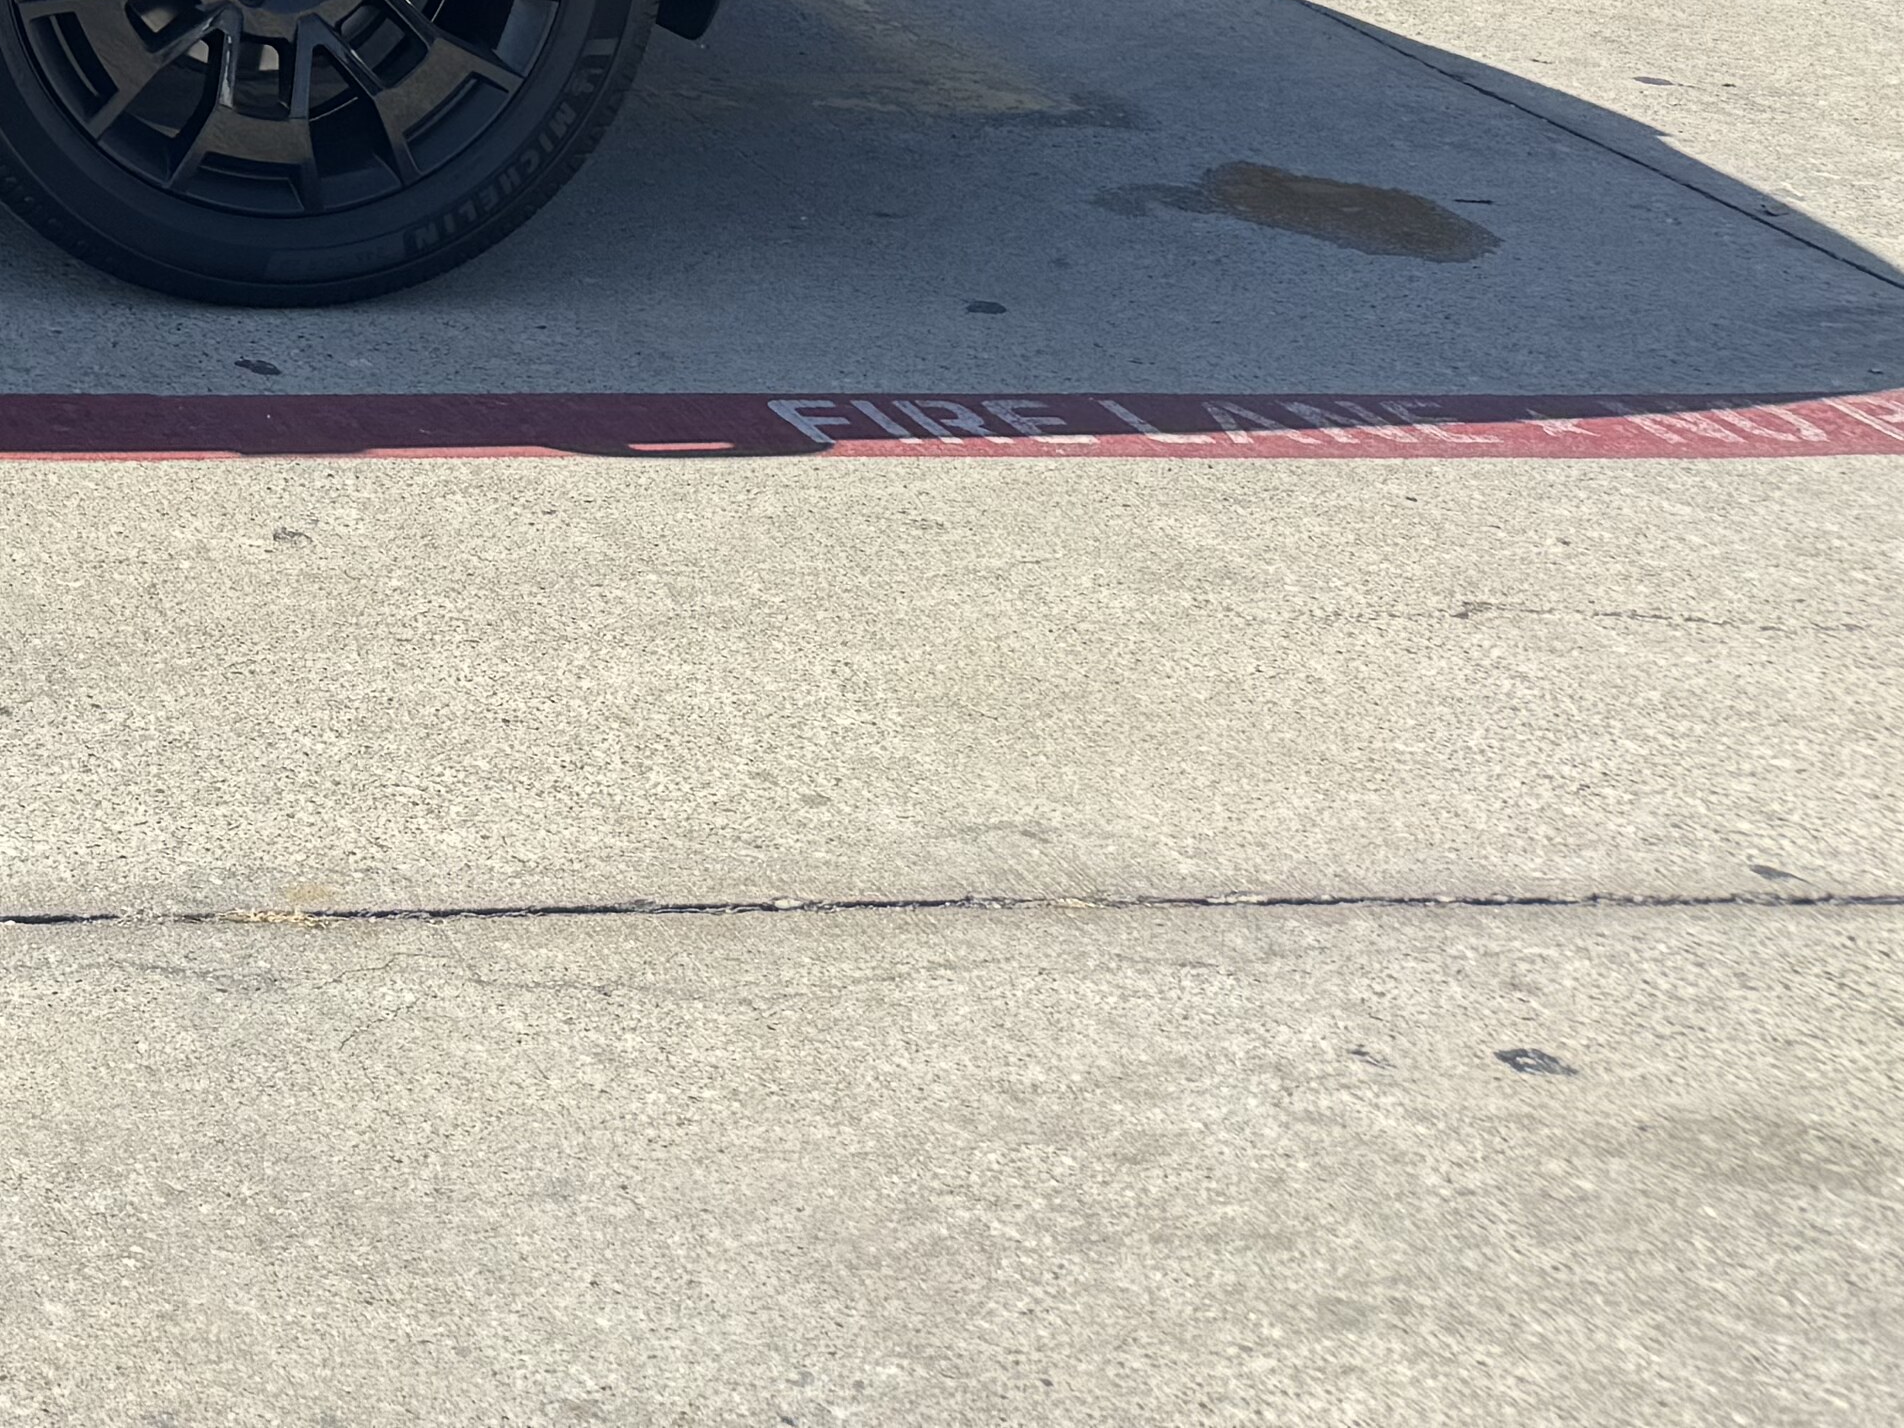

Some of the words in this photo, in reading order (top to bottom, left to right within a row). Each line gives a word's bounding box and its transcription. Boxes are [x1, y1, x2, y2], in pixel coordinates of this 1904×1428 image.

[415, 101, 579, 250] MICHELIN
[766, 398, 1100, 445] FIRE
[1098, 398, 1503, 445] LANE
[1595, 399, 1830, 445] NO
